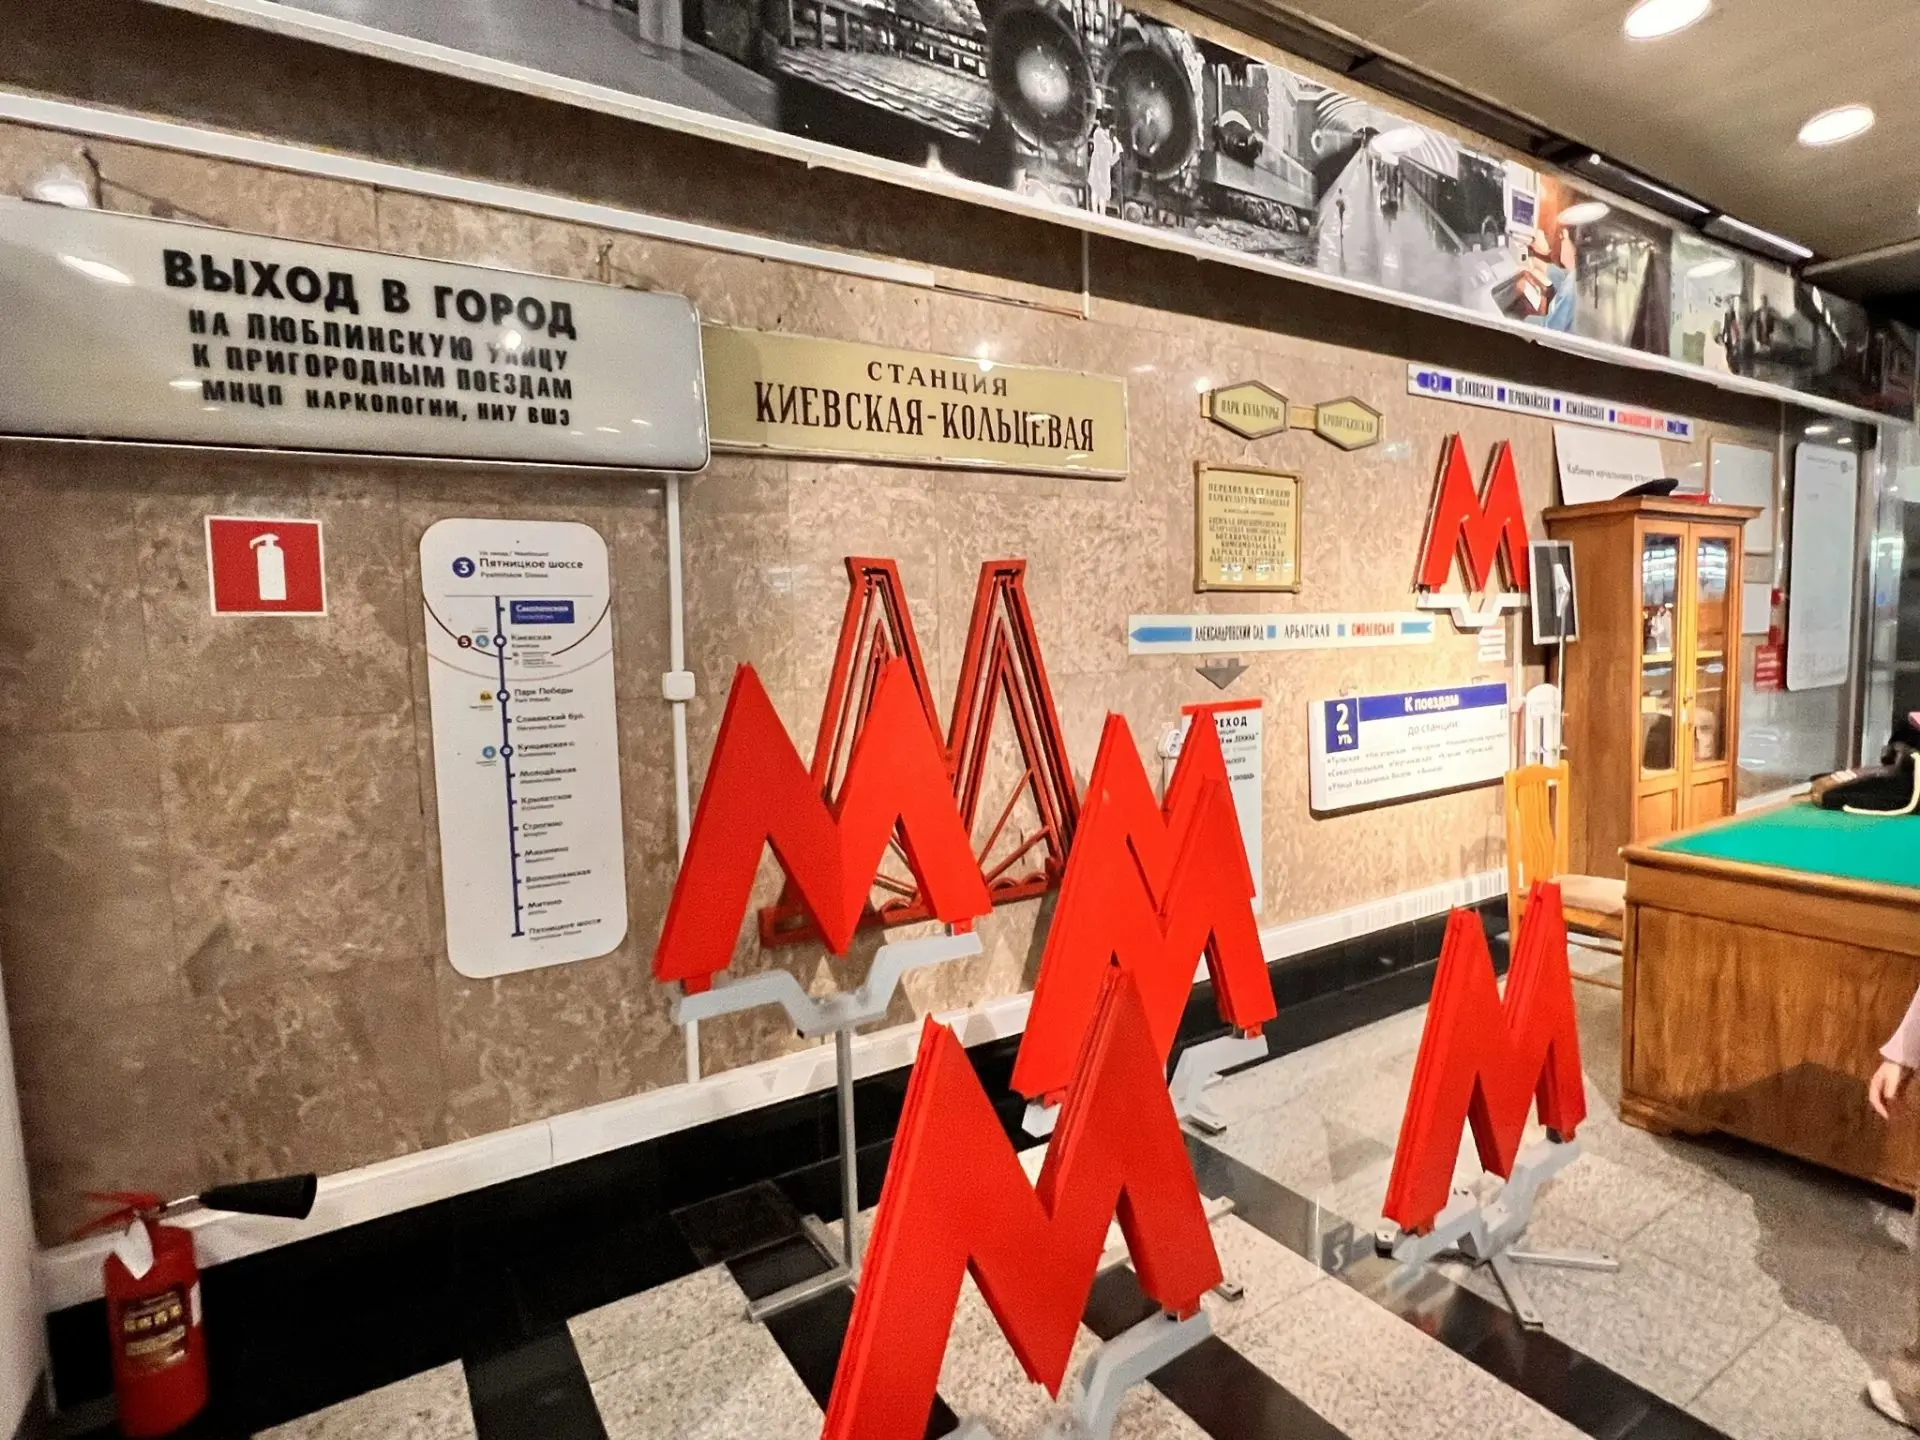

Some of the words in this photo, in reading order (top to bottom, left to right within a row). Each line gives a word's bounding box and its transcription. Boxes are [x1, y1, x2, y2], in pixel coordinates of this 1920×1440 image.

[163, 249, 359, 315] ВЫХОД
[382, 278, 410, 314] В
[434, 285, 577, 340] ГОРОД
[189, 309, 229, 337] НА
[193, 343, 210, 368] К
[226, 346, 445, 388] ПРИГОРОДНЫМ
[457, 368, 572, 400] ПОЕЗДАМ
[867, 361, 1008, 397] СТАНЦИЯ
[477, 402, 517, 422] НИУ
[528, 406, 570, 426] ВШЭ
[754, 381, 1094, 452] КИЕВСКАЯ-КОЛЬЦЕВАЯ
[1221, 399, 1240, 414] ПАРК
[479, 558, 546, 571] Пятницкое
[548, 560, 584, 570] шоссе
[1284, 622, 1330, 639] АРБАТСКАЯ
[1404, 697, 1414, 713] К
[1414, 693, 1460, 712] поездам
[1336, 703, 1349, 732] 2
